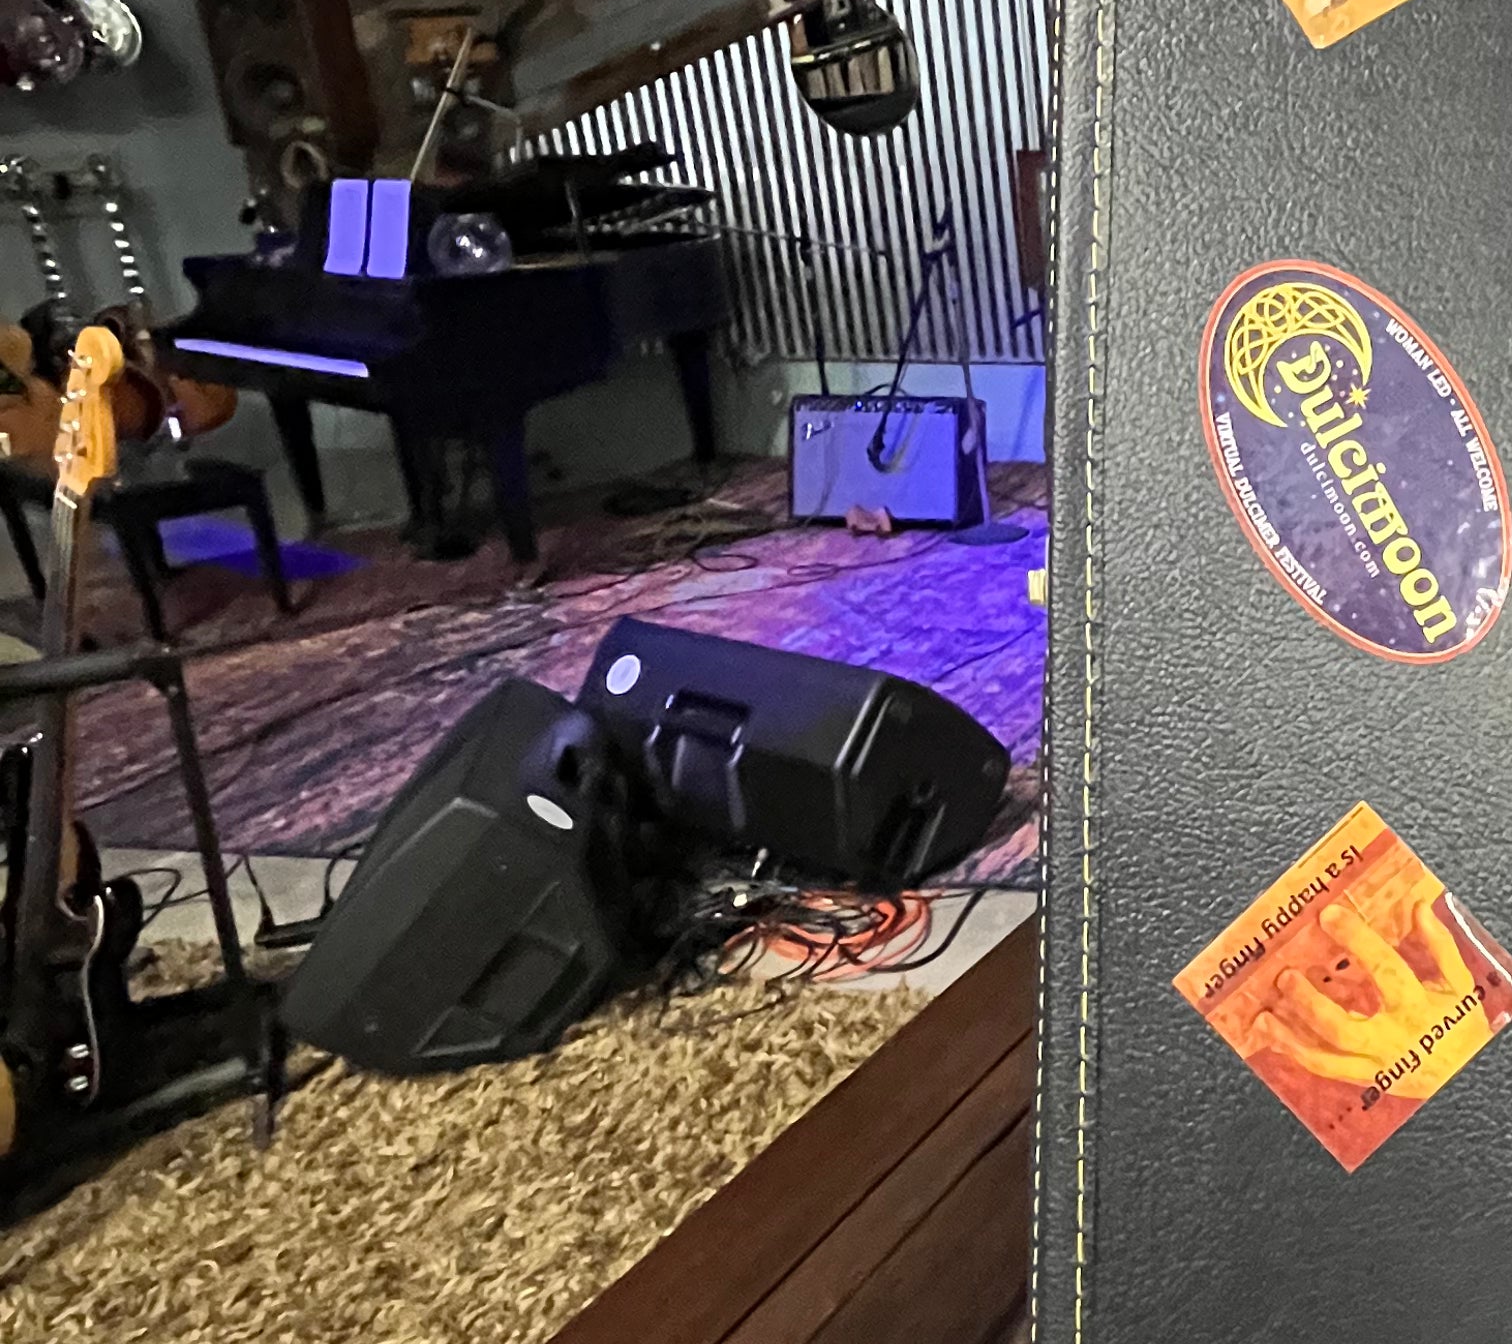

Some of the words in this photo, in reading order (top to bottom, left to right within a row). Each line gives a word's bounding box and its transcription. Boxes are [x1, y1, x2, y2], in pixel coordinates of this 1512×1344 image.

[1384, 317, 1432, 373] WOMAN
[1426, 366, 1453, 399] LED
[1451, 408, 1474, 439] ALL
[1465, 436, 1499, 513] WELCOME
[1215, 411, 1243, 478] VIRTUAL
[1234, 478, 1282, 552] DULCIMER
[1274, 545, 1328, 606] FESTIVAL
[1276, 341, 1458, 644] Dulcimoon
[1299, 441, 1380, 580] dulcimoon.com
[1260, 876, 1330, 940] happy
[1325, 862, 1342, 880] a
[1205, 937, 1266, 999] finger
[1418, 981, 1487, 1056] curved
[1360, 1049, 1422, 1111] finger
